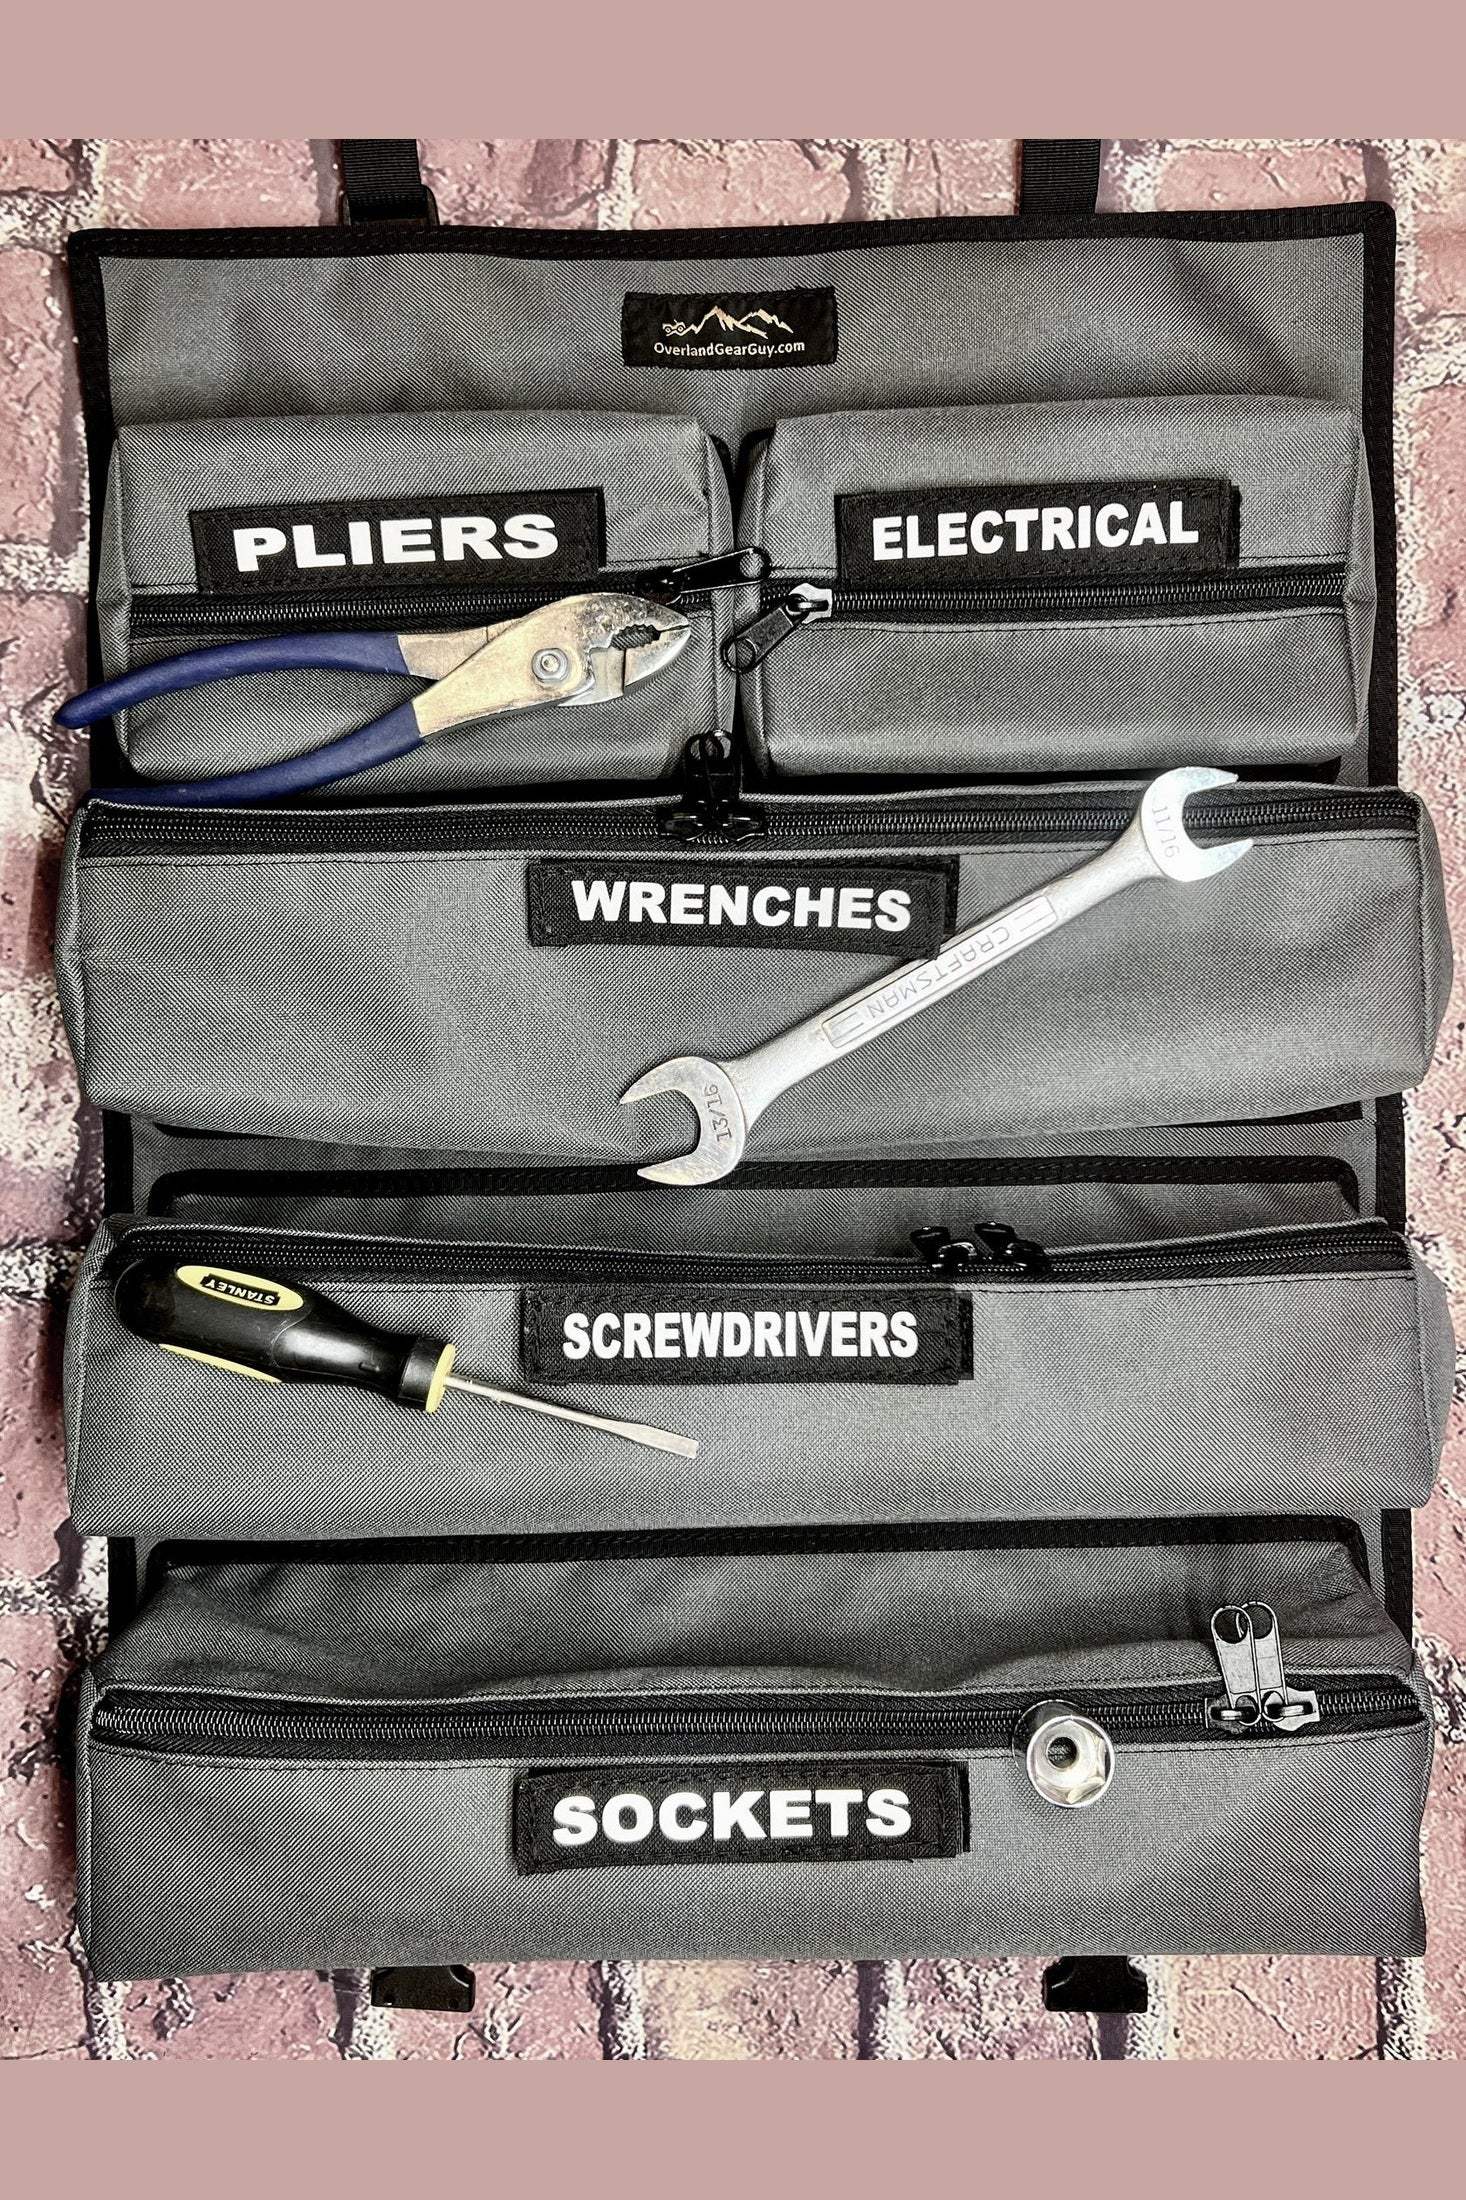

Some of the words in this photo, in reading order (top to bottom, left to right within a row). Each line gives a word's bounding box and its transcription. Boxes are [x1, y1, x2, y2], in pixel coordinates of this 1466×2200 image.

[654, 342, 805, 358] OverlandGearGuy.com
[234, 515, 557, 571] PLIERS
[873, 501, 1198, 560] ELECTRICAL
[1152, 806, 1180, 857] 11/16
[572, 881, 910, 931] WRENCHES
[866, 926, 1011, 1018] CRAFTSMAN
[704, 1084, 732, 1142] 13/16
[205, 1279, 275, 1304] STANLEY
[563, 1312, 917, 1359] SCREWDRIVERS
[553, 1789, 911, 1845] SOCKETS
